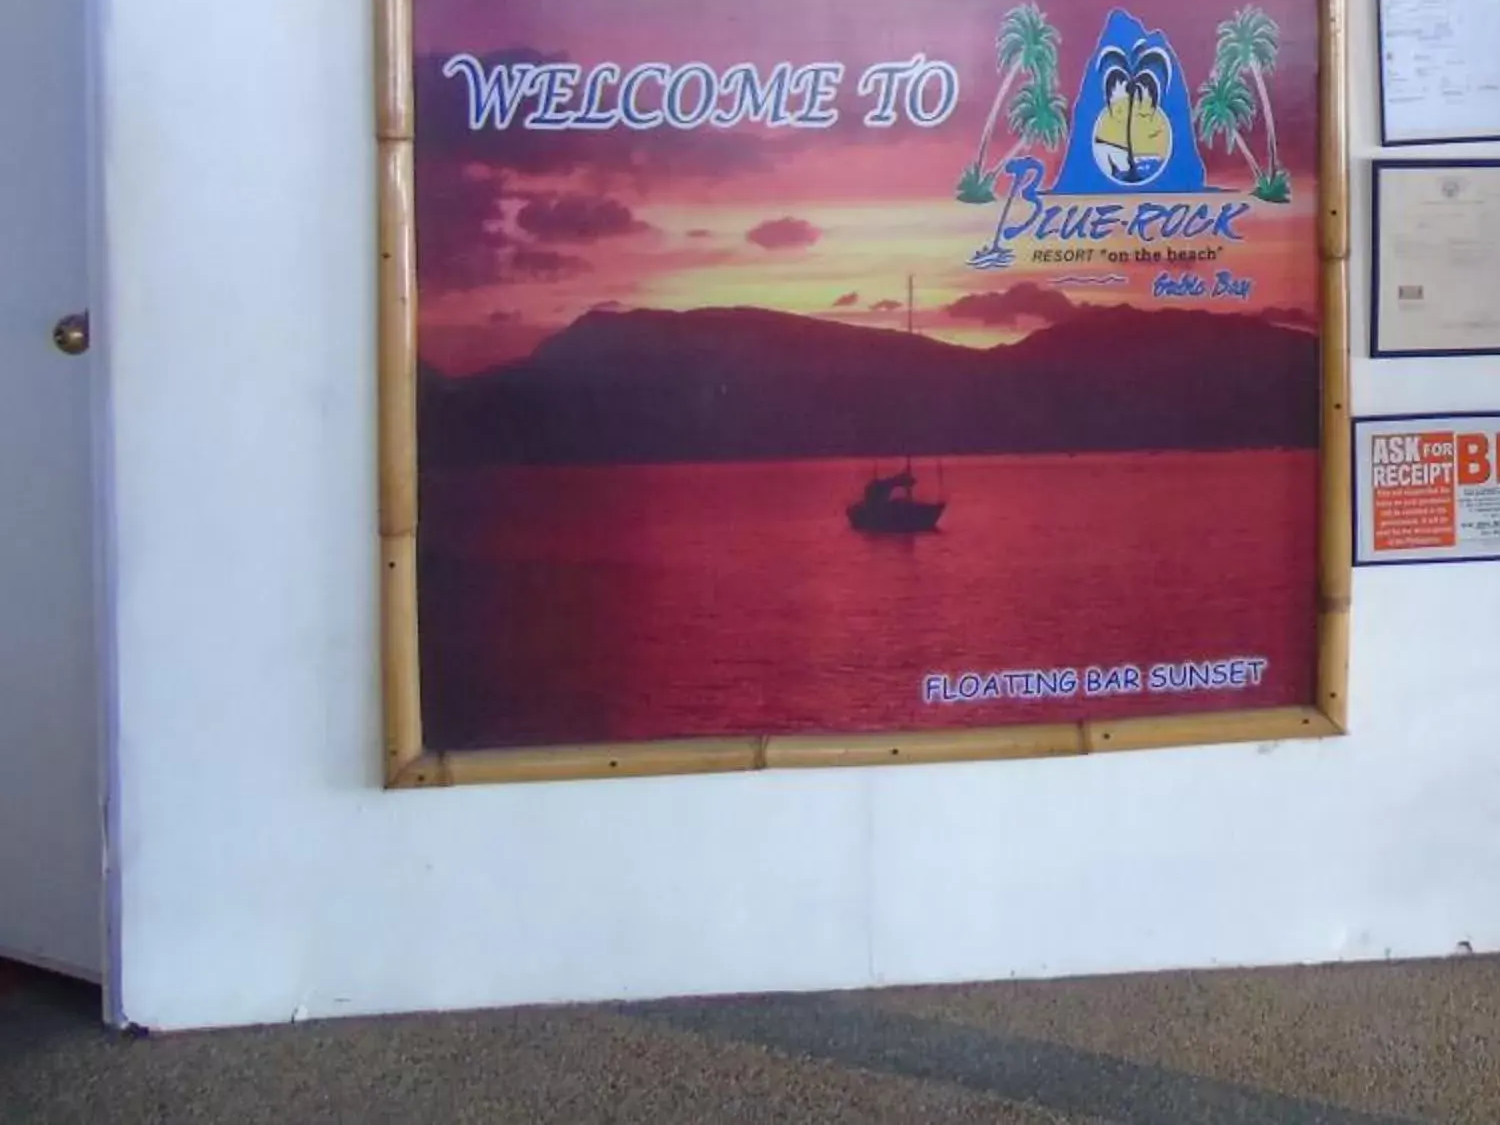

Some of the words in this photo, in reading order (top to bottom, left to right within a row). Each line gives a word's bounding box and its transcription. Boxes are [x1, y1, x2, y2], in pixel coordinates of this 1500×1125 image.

[443, 53, 845, 129] WELCOME
[858, 52, 960, 128] TO
[1031, 249, 1095, 264] RESORT
[1134, 247, 1161, 262] the
[1373, 436, 1421, 463] ASK
[1422, 440, 1453, 459] FOR
[1373, 463, 1453, 487] RECEIPT
[925, 668, 1077, 704] FLOATING
[1086, 665, 1140, 696] BAR
[1149, 658, 1266, 690] SUNSET
